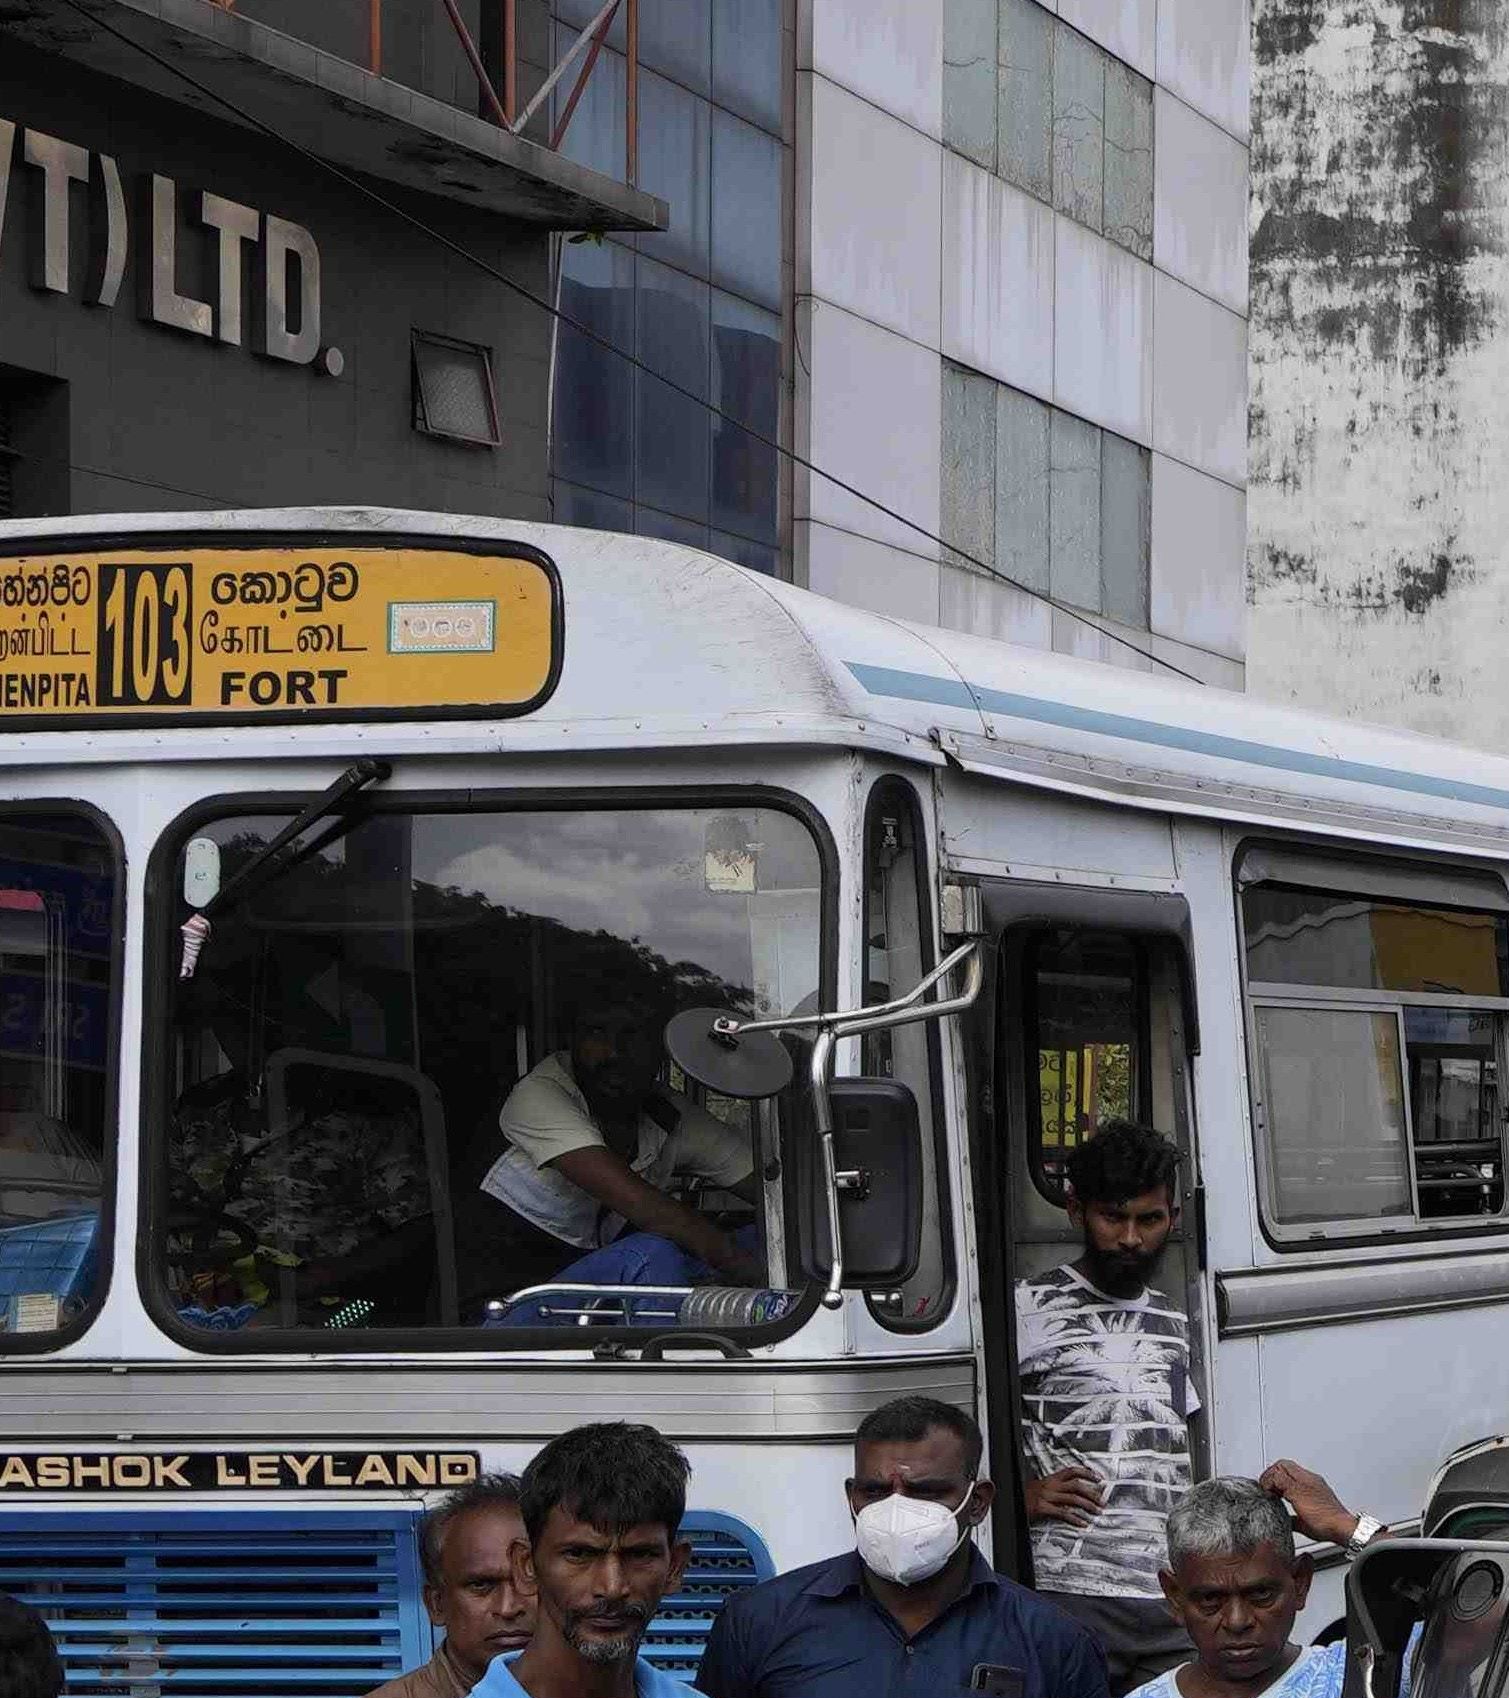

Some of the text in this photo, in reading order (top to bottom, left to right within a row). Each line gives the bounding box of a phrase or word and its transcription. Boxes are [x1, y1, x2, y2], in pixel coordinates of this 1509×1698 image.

[152, 172, 345, 377] LTD.
[211, 562, 361, 613] කොටුව
[105, 566, 190, 701] 103
[0, 672, 91, 708] ENPITA
[220, 669, 348, 706] FORT
[0, 1454, 477, 1487] ASHOK LEYLAND
